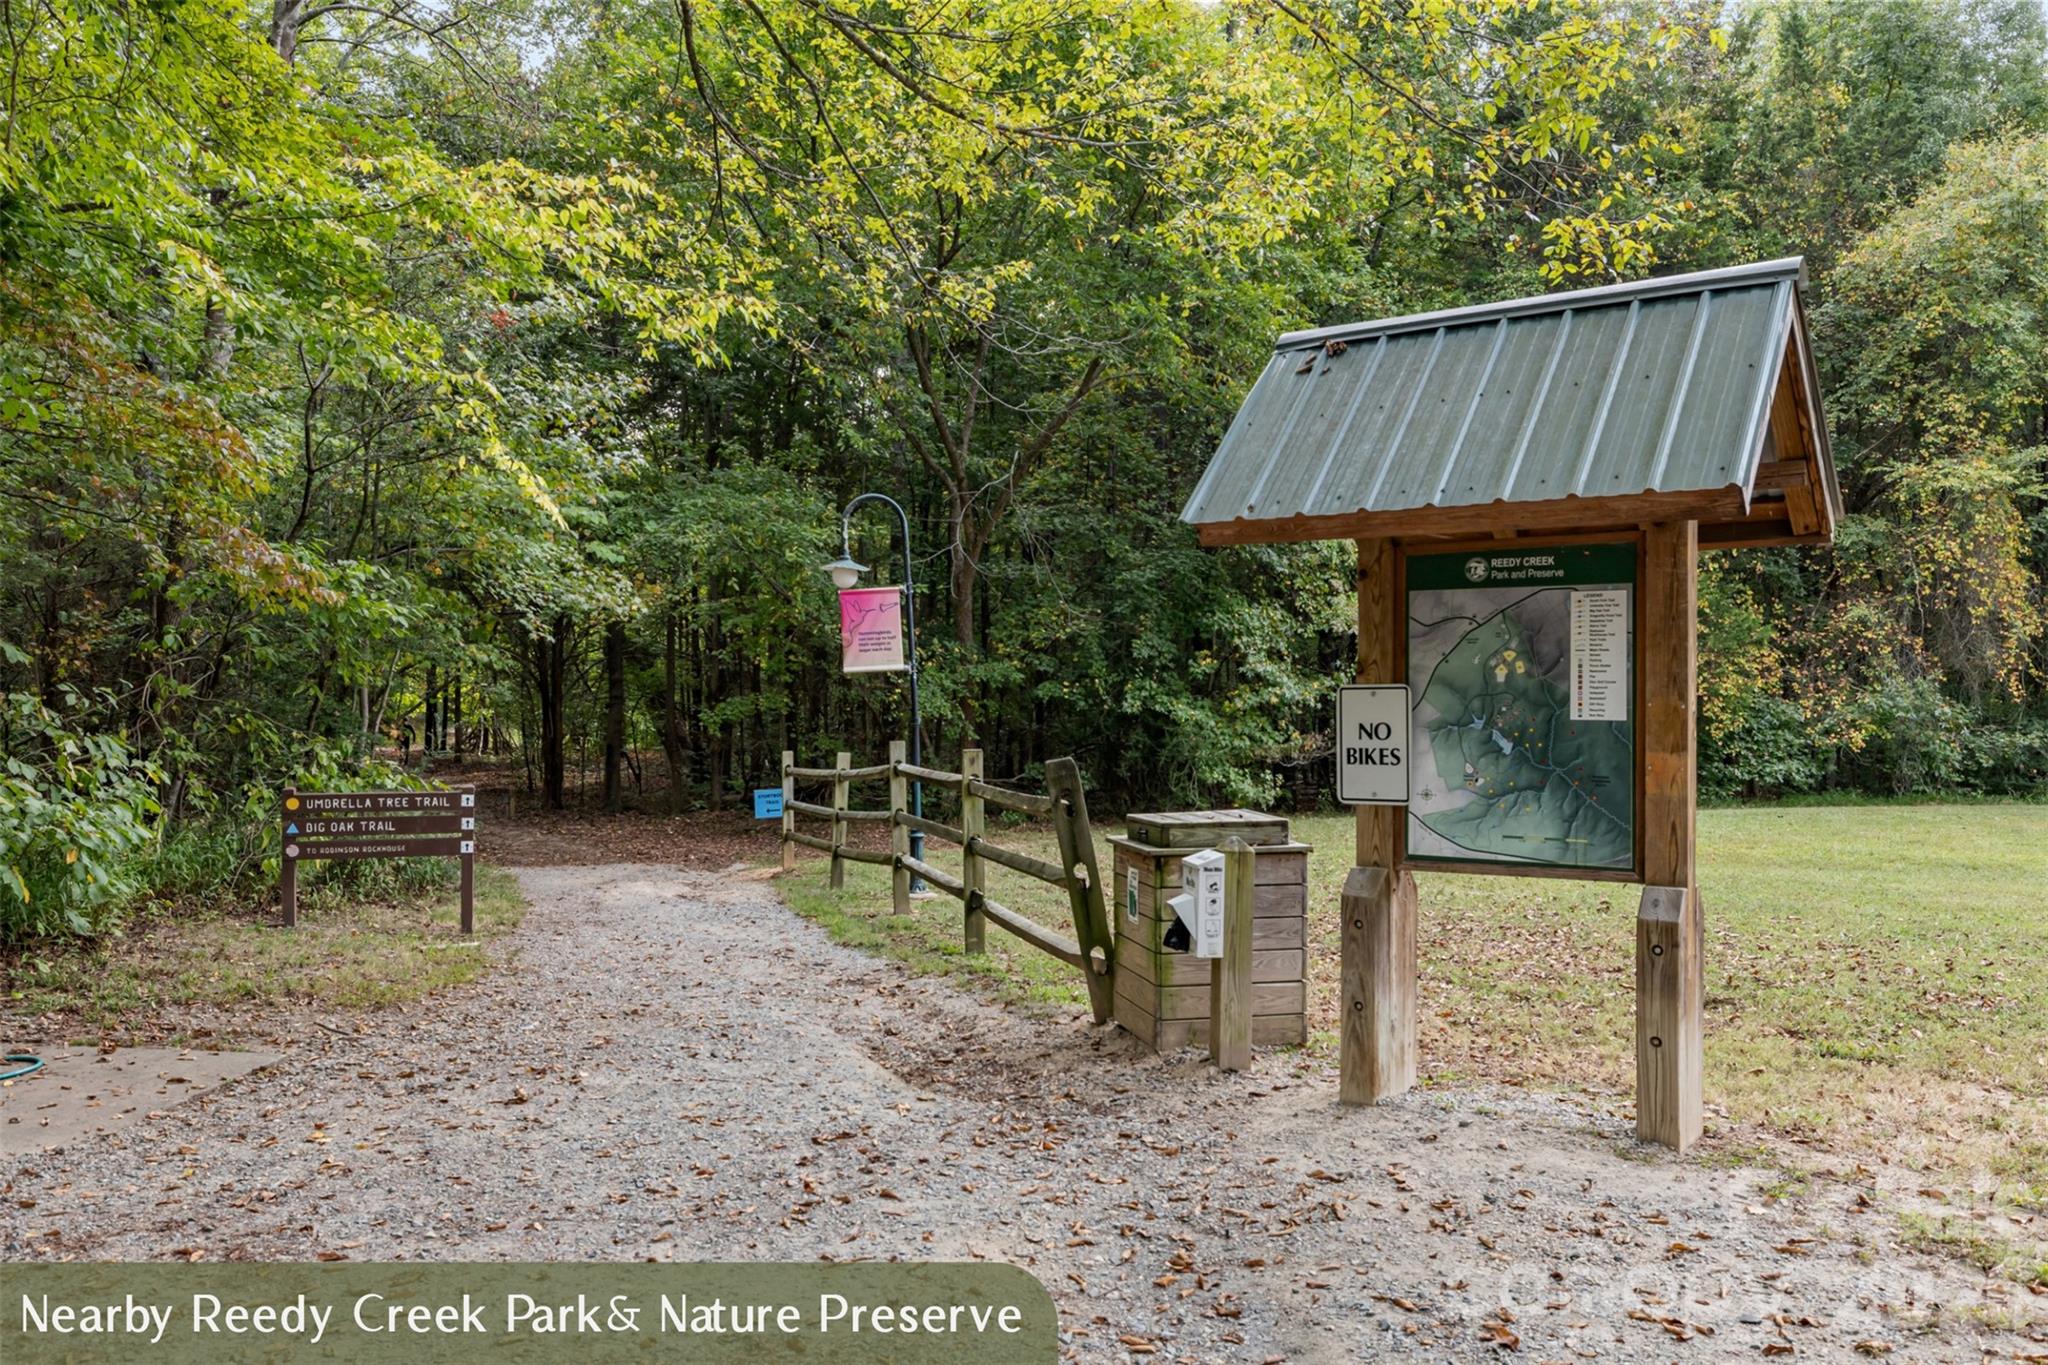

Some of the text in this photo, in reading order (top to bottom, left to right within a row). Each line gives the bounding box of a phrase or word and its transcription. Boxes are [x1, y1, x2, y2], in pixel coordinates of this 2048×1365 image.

[1491, 556, 1555, 568] REEDY CREEK
[1491, 569, 1564, 580] Park and Preserve
[1358, 722, 1391, 741] NO
[1346, 747, 1401, 766] BIKES
[306, 796, 450, 809] UMBRELLA TREE TRAIL
[306, 821, 396, 833] BIG OAK TRAIL
[320, 846, 359, 854] ROBINSON
